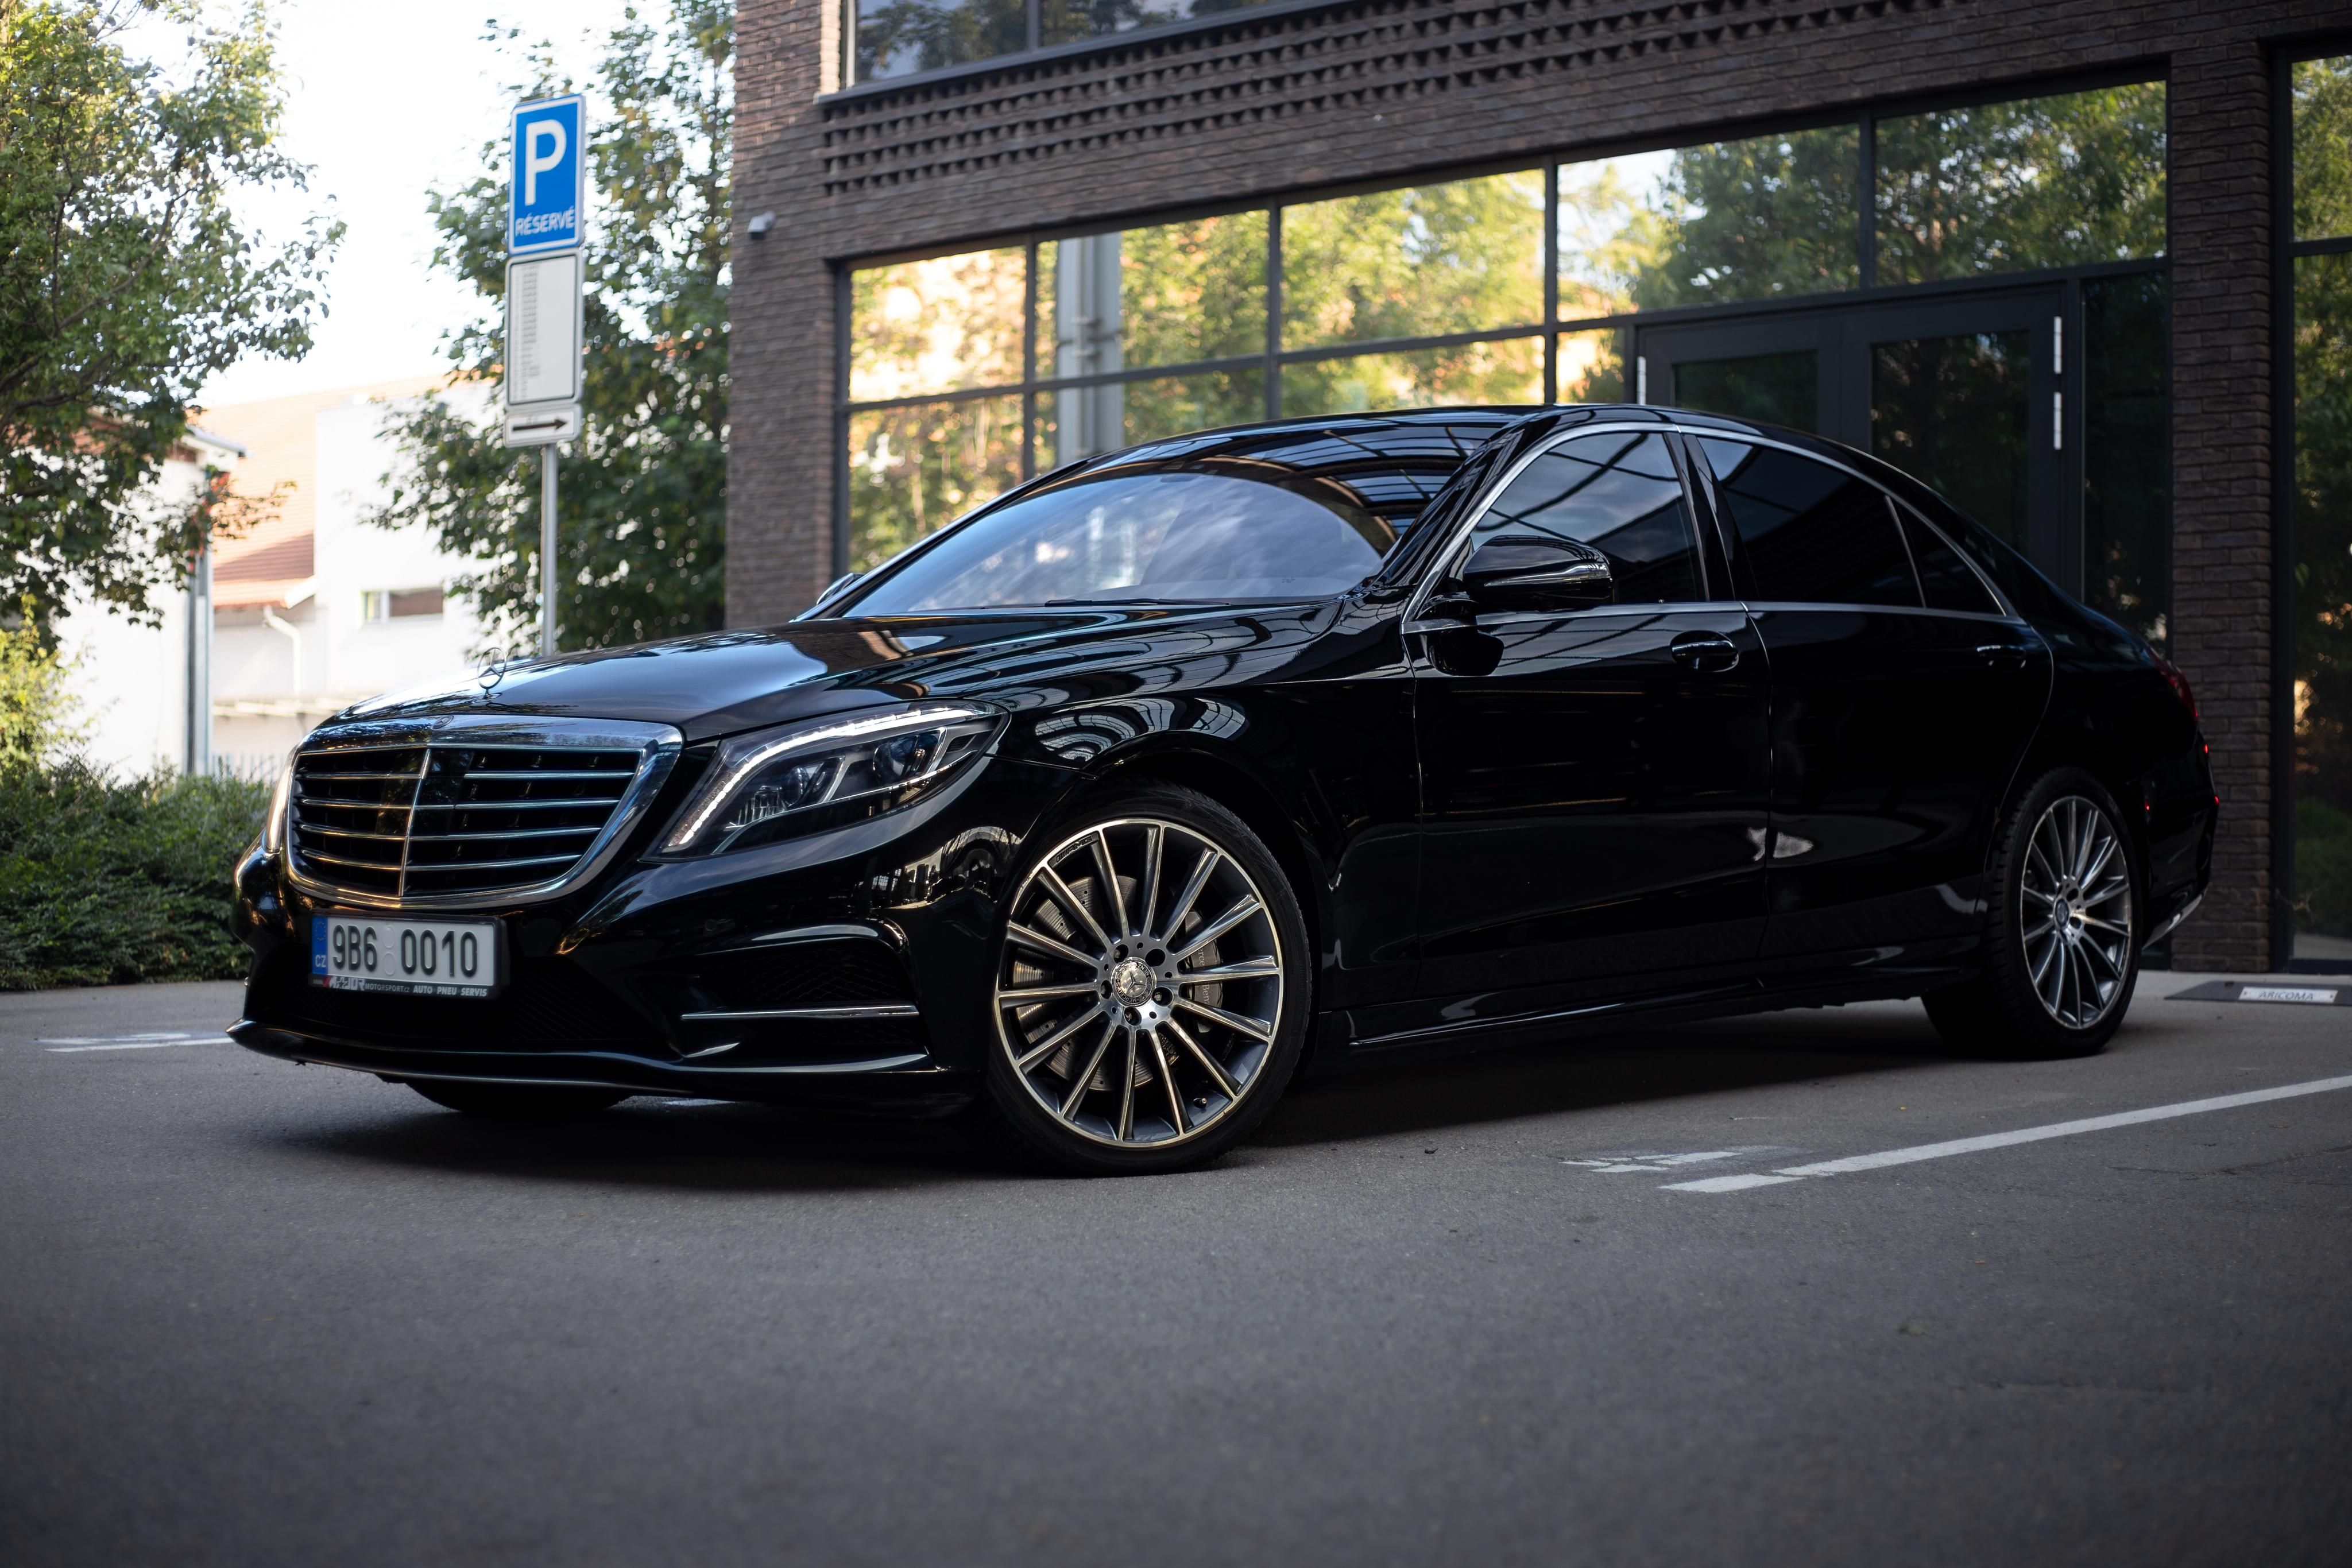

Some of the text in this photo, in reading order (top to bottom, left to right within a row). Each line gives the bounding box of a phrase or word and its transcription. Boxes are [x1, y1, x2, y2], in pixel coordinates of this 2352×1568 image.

[525, 119, 567, 206] P
[515, 206, 575, 237] RÉSERVÉ
[333, 924, 478, 978] 9B6 0010
[315, 954, 327, 968] CZ
[1138, 964, 1150, 976] BENZ
[413, 985, 433, 994] AUTO
[437, 986, 458, 996] PNEU
[461, 988, 488, 997] SERVIS
[2258, 991, 2315, 1000] ARICOMA
